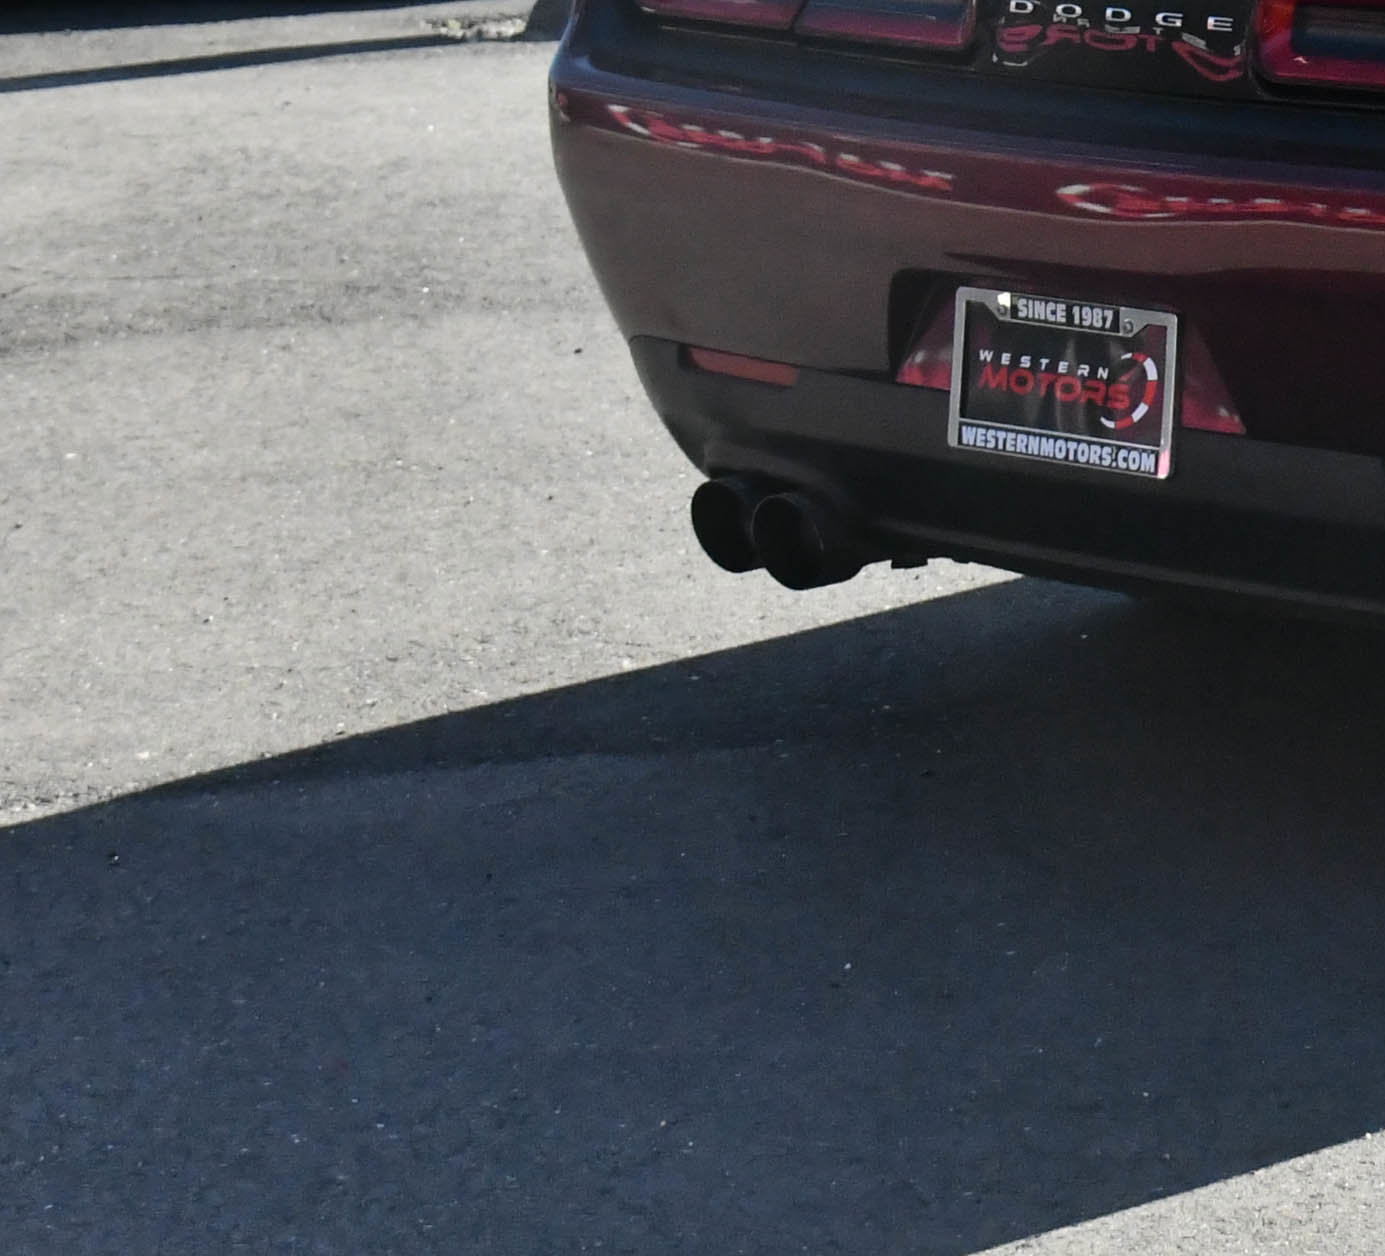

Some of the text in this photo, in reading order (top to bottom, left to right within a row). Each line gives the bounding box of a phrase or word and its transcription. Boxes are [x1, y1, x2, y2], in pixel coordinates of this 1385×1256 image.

[1017, 298, 1114, 330] SINCE 1987
[978, 349, 1109, 380] WESTERN
[976, 363, 1131, 410] MOTORS
[960, 425, 1156, 473] WESTERNMOTORS.COM
